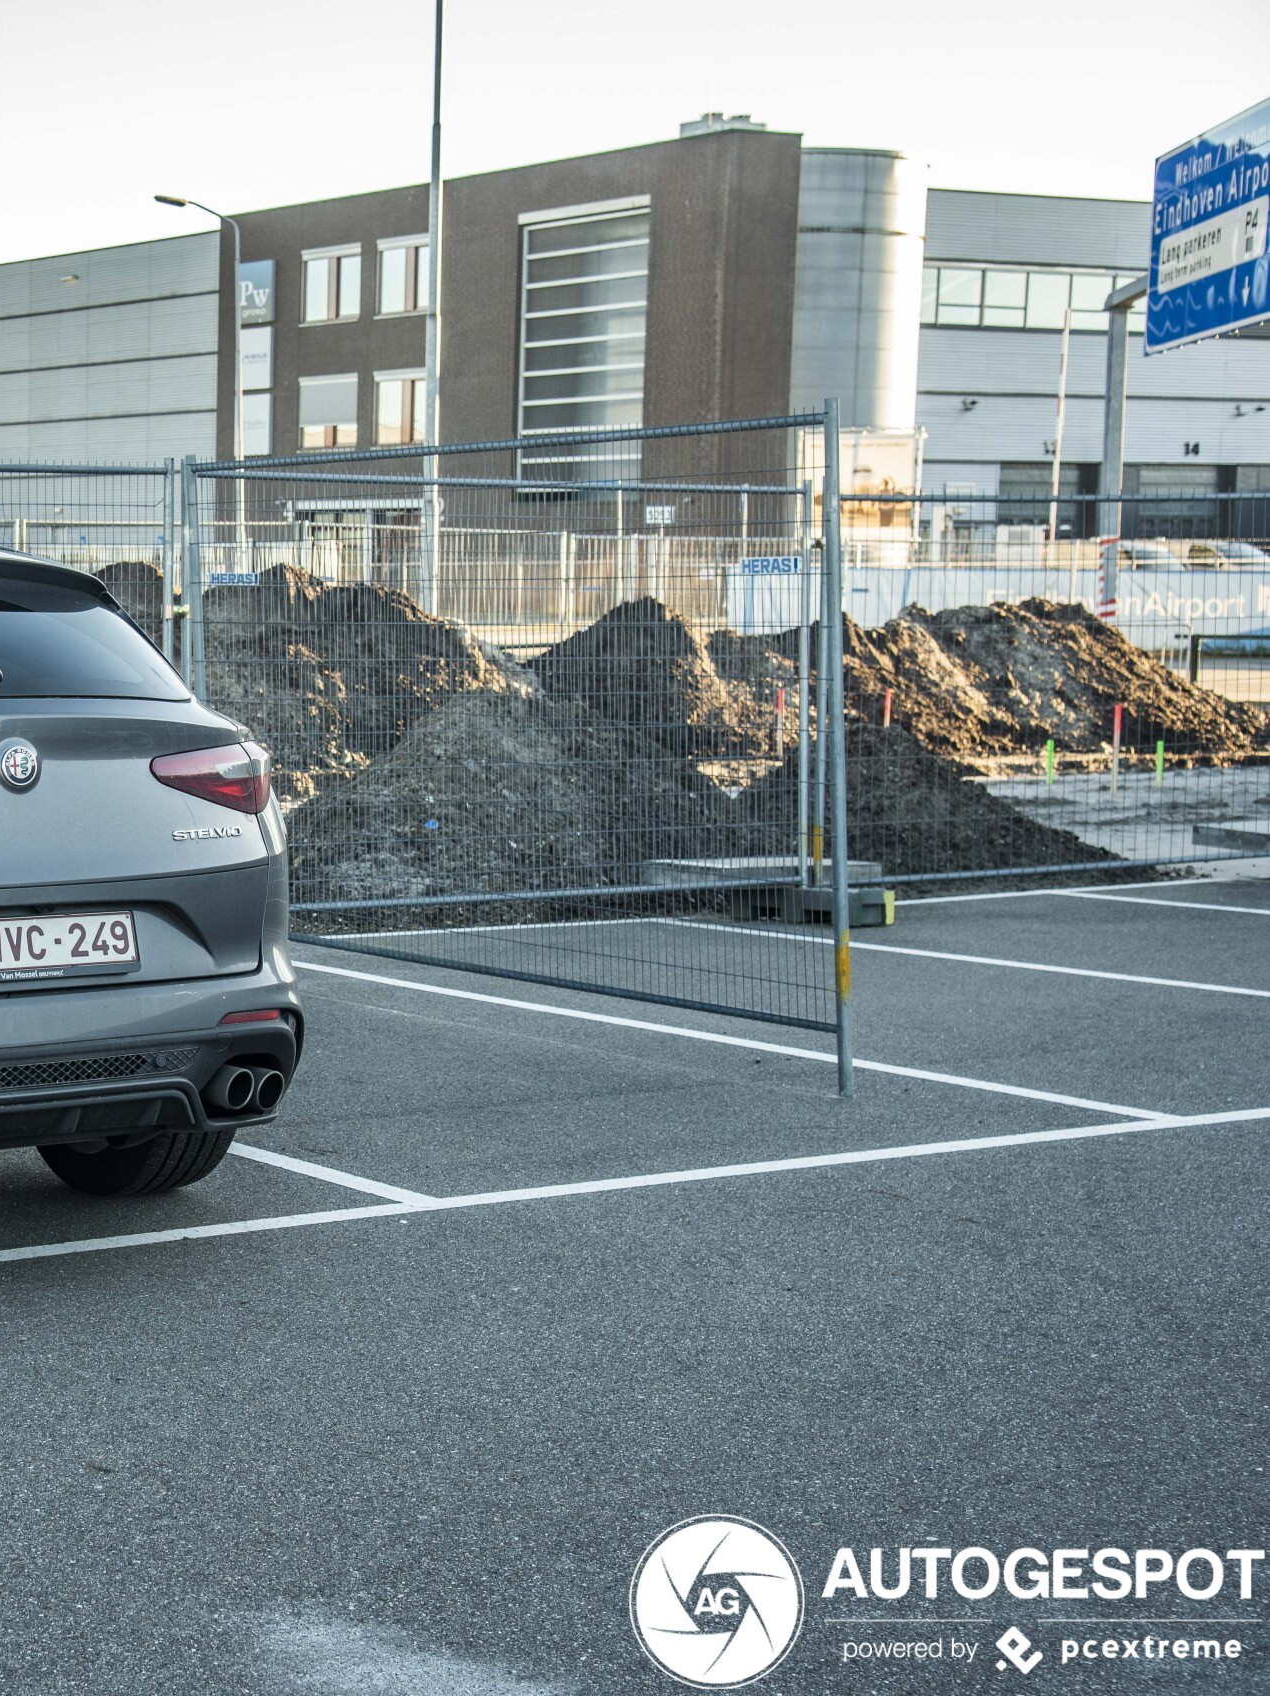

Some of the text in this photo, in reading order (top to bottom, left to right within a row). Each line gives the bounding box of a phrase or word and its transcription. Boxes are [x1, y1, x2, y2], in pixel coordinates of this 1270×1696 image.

[1174, 151, 1212, 187] Welkom
[1225, 124, 1270, 162] Welcom
[1154, 183, 1223, 236] Eindhoven
[1161, 209, 1259, 265] Lang parkeren P4
[1188, 254, 1212, 277] parking
[1183, 441, 1201, 457] 14
[172, 825, 243, 841] STELVIO
[0, 972, 14, 980] Van
[14, 969, 38, 979] Mossel
